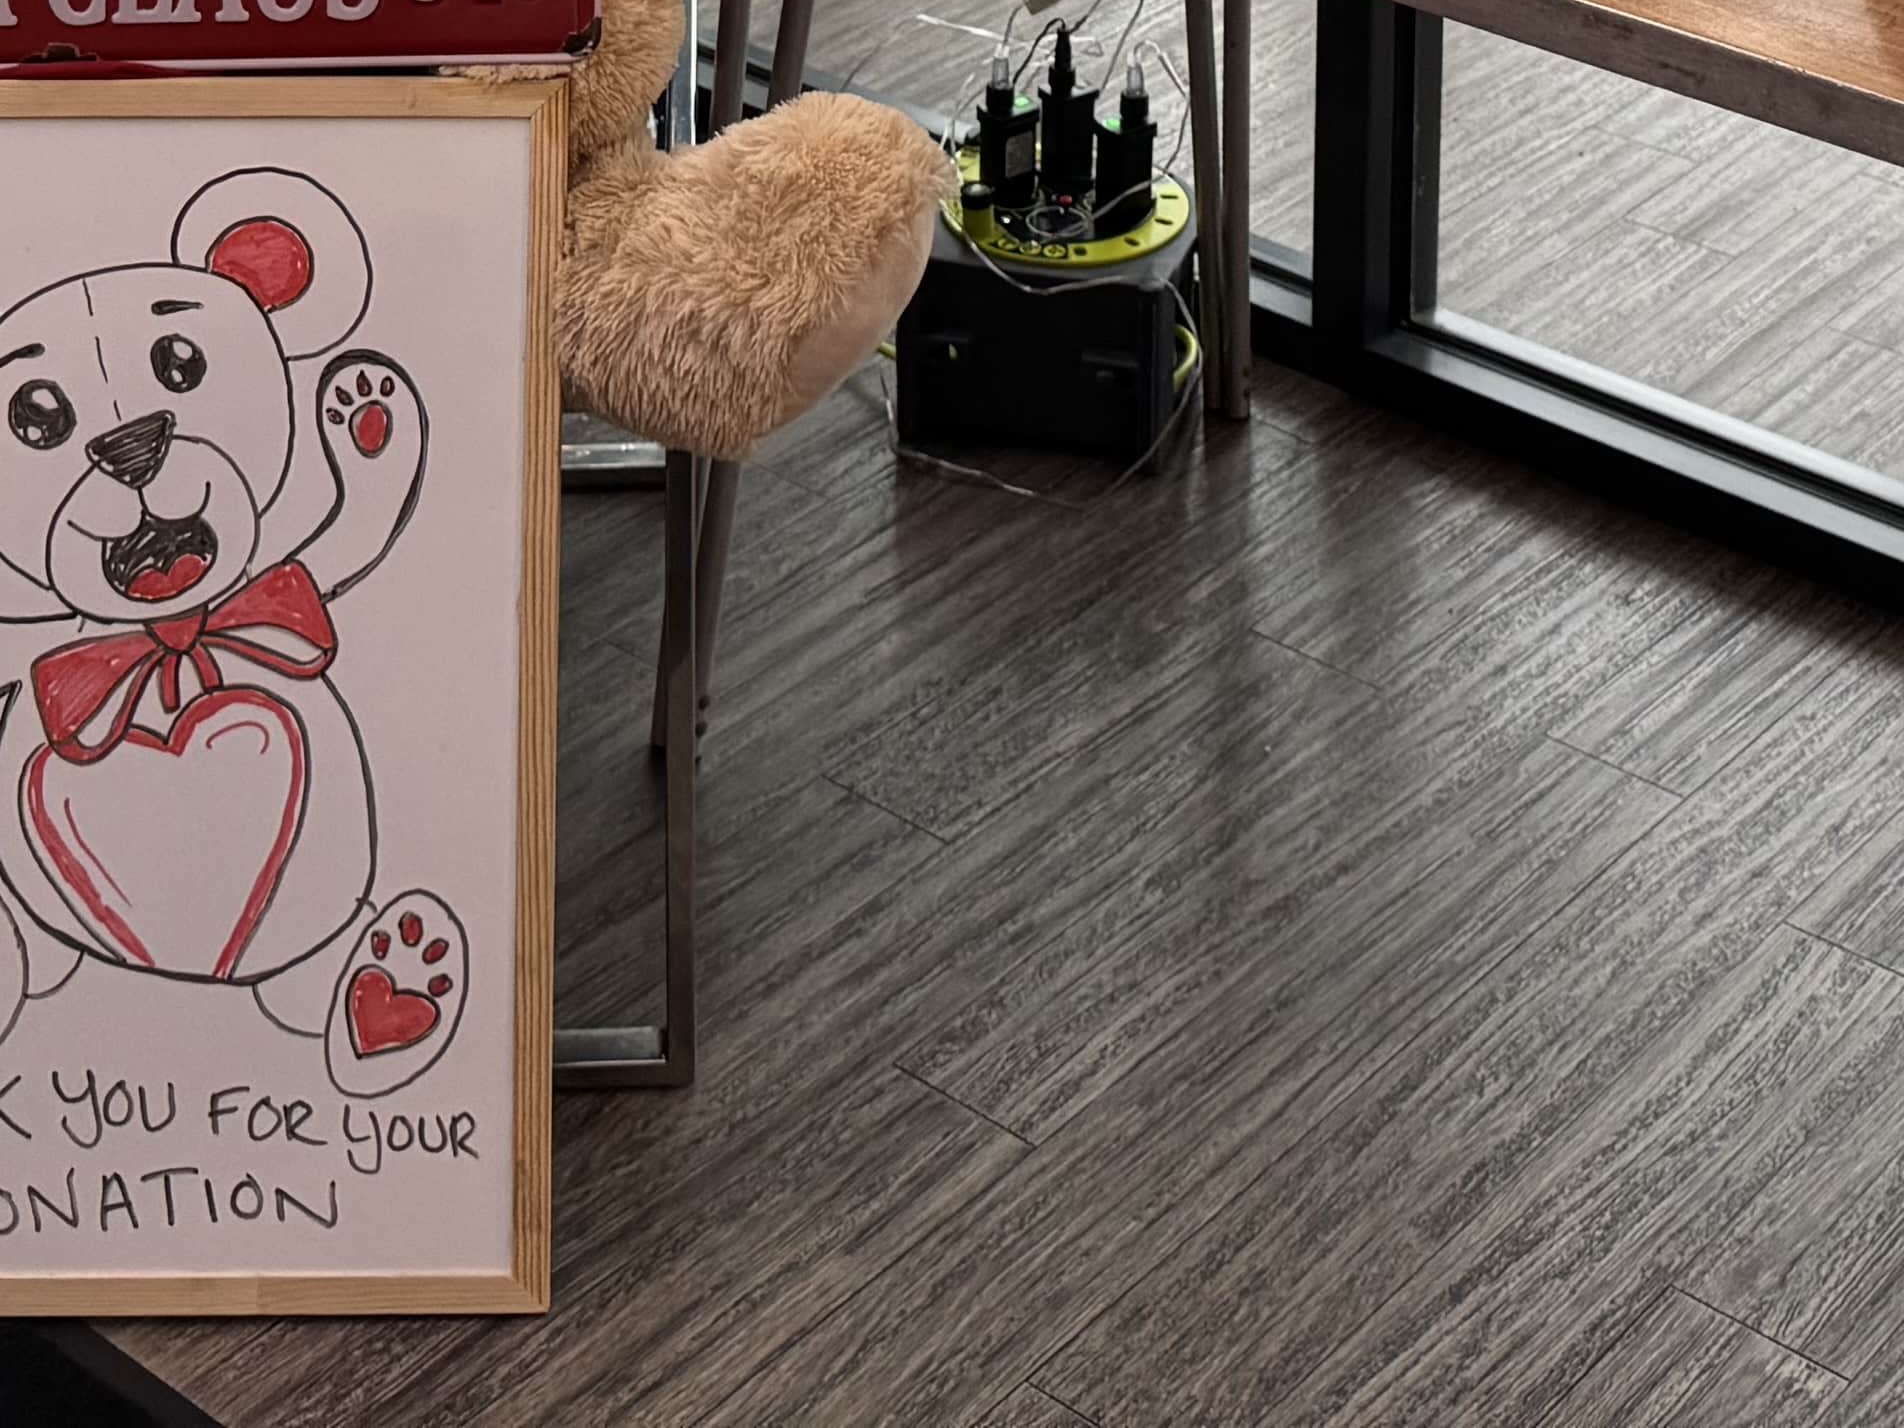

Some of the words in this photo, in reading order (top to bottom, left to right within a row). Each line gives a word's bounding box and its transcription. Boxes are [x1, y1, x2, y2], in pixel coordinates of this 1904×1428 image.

[52, 1068, 178, 1148] YOU
[206, 1084, 329, 1146] FOR
[343, 1104, 481, 1176] YOUR
